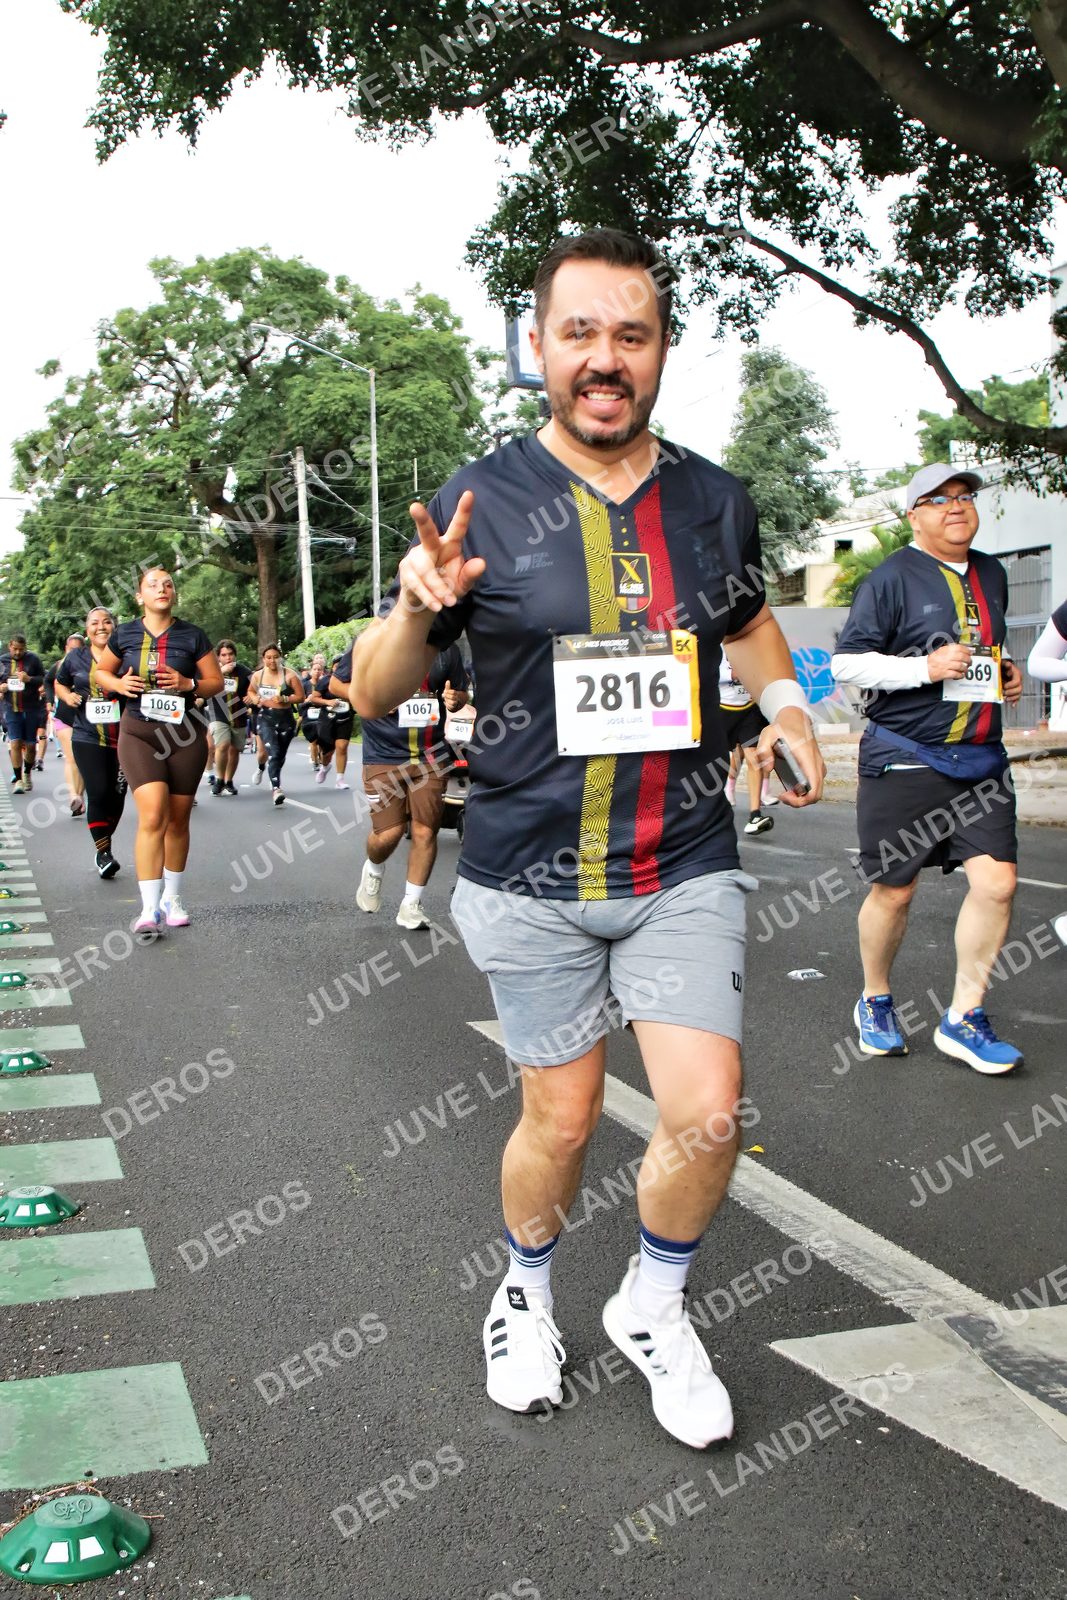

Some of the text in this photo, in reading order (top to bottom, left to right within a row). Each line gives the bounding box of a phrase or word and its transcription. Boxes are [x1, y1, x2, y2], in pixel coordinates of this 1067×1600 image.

[675, 640, 692, 651] 5K
[575, 669, 671, 713] 2816
[95, 705, 112, 714] 857
[150, 698, 177, 711] 1065
[406, 703, 433, 715] 1067
